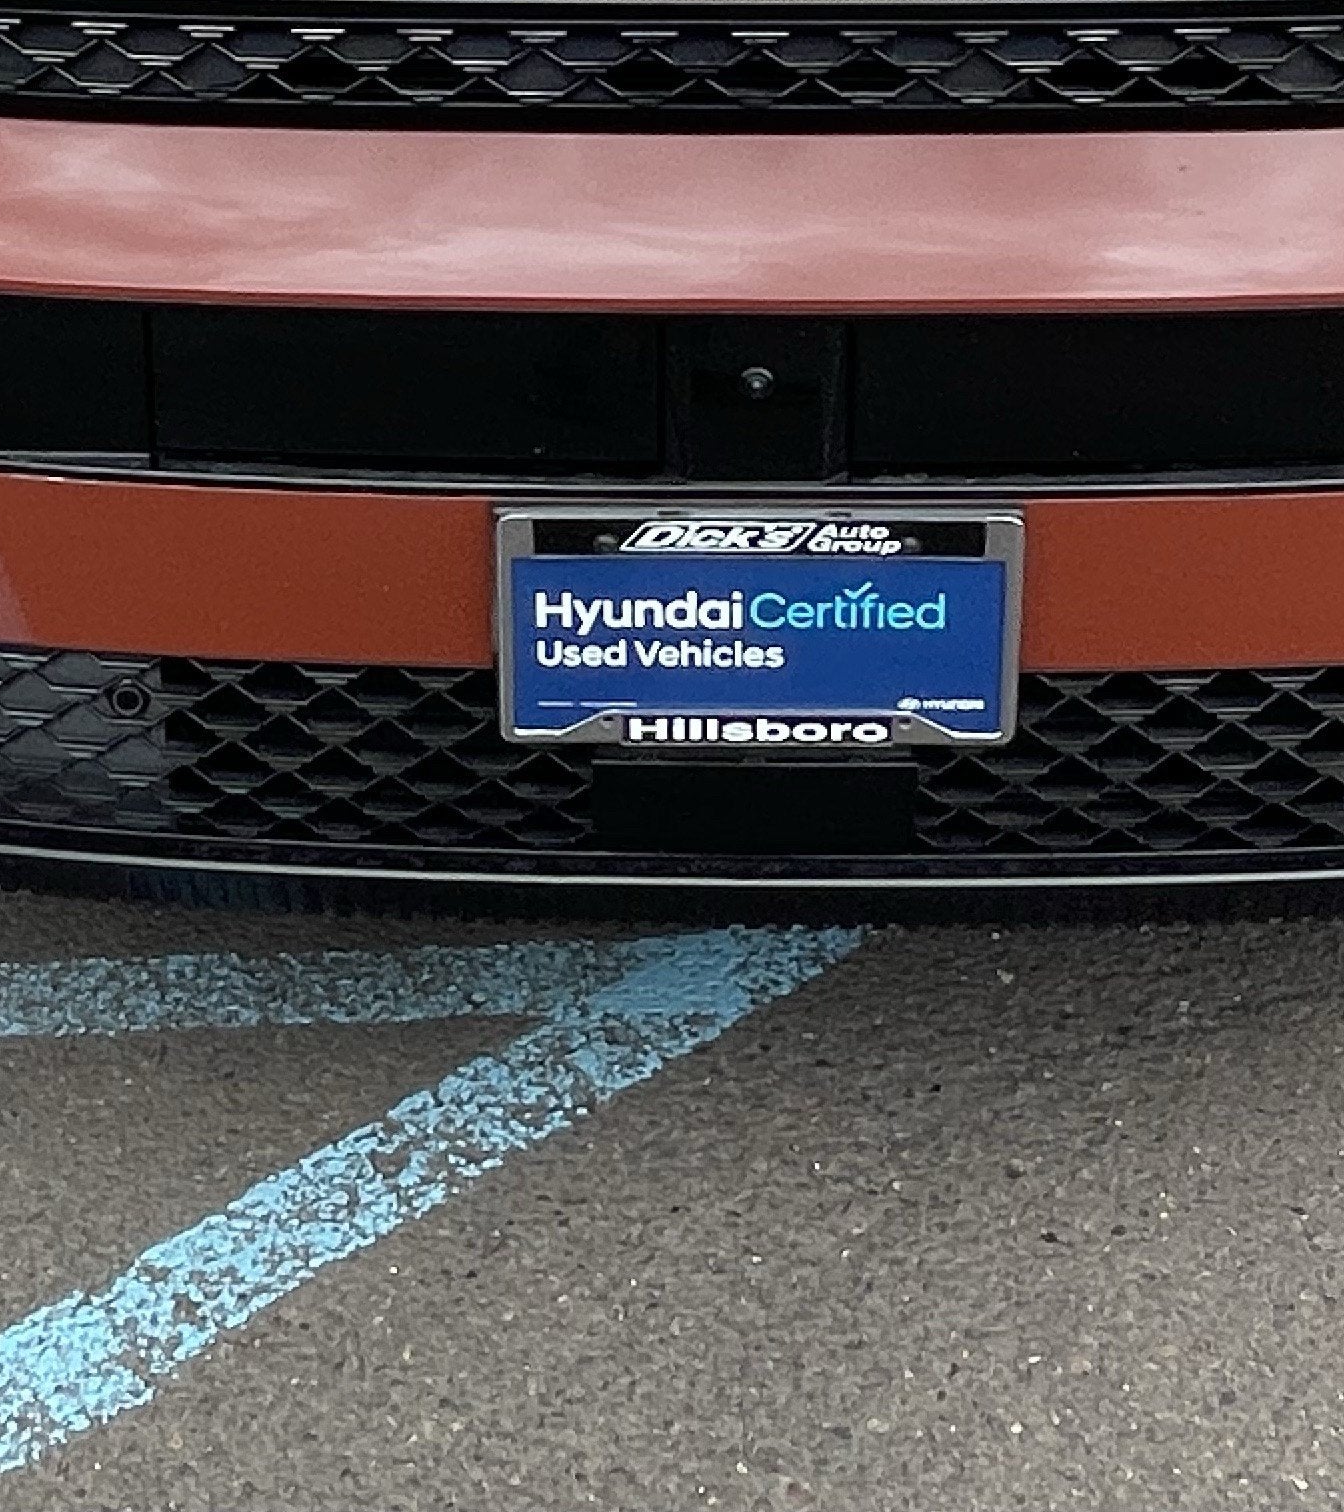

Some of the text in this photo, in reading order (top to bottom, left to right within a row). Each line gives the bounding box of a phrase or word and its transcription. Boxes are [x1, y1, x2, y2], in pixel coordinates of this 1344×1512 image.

[821, 523, 890, 540] Auto
[807, 536, 902, 555] Group
[535, 582, 947, 636] Hyundai Certified
[537, 638, 785, 668] Used Vehicles
[628, 718, 890, 742] Hillsboro
